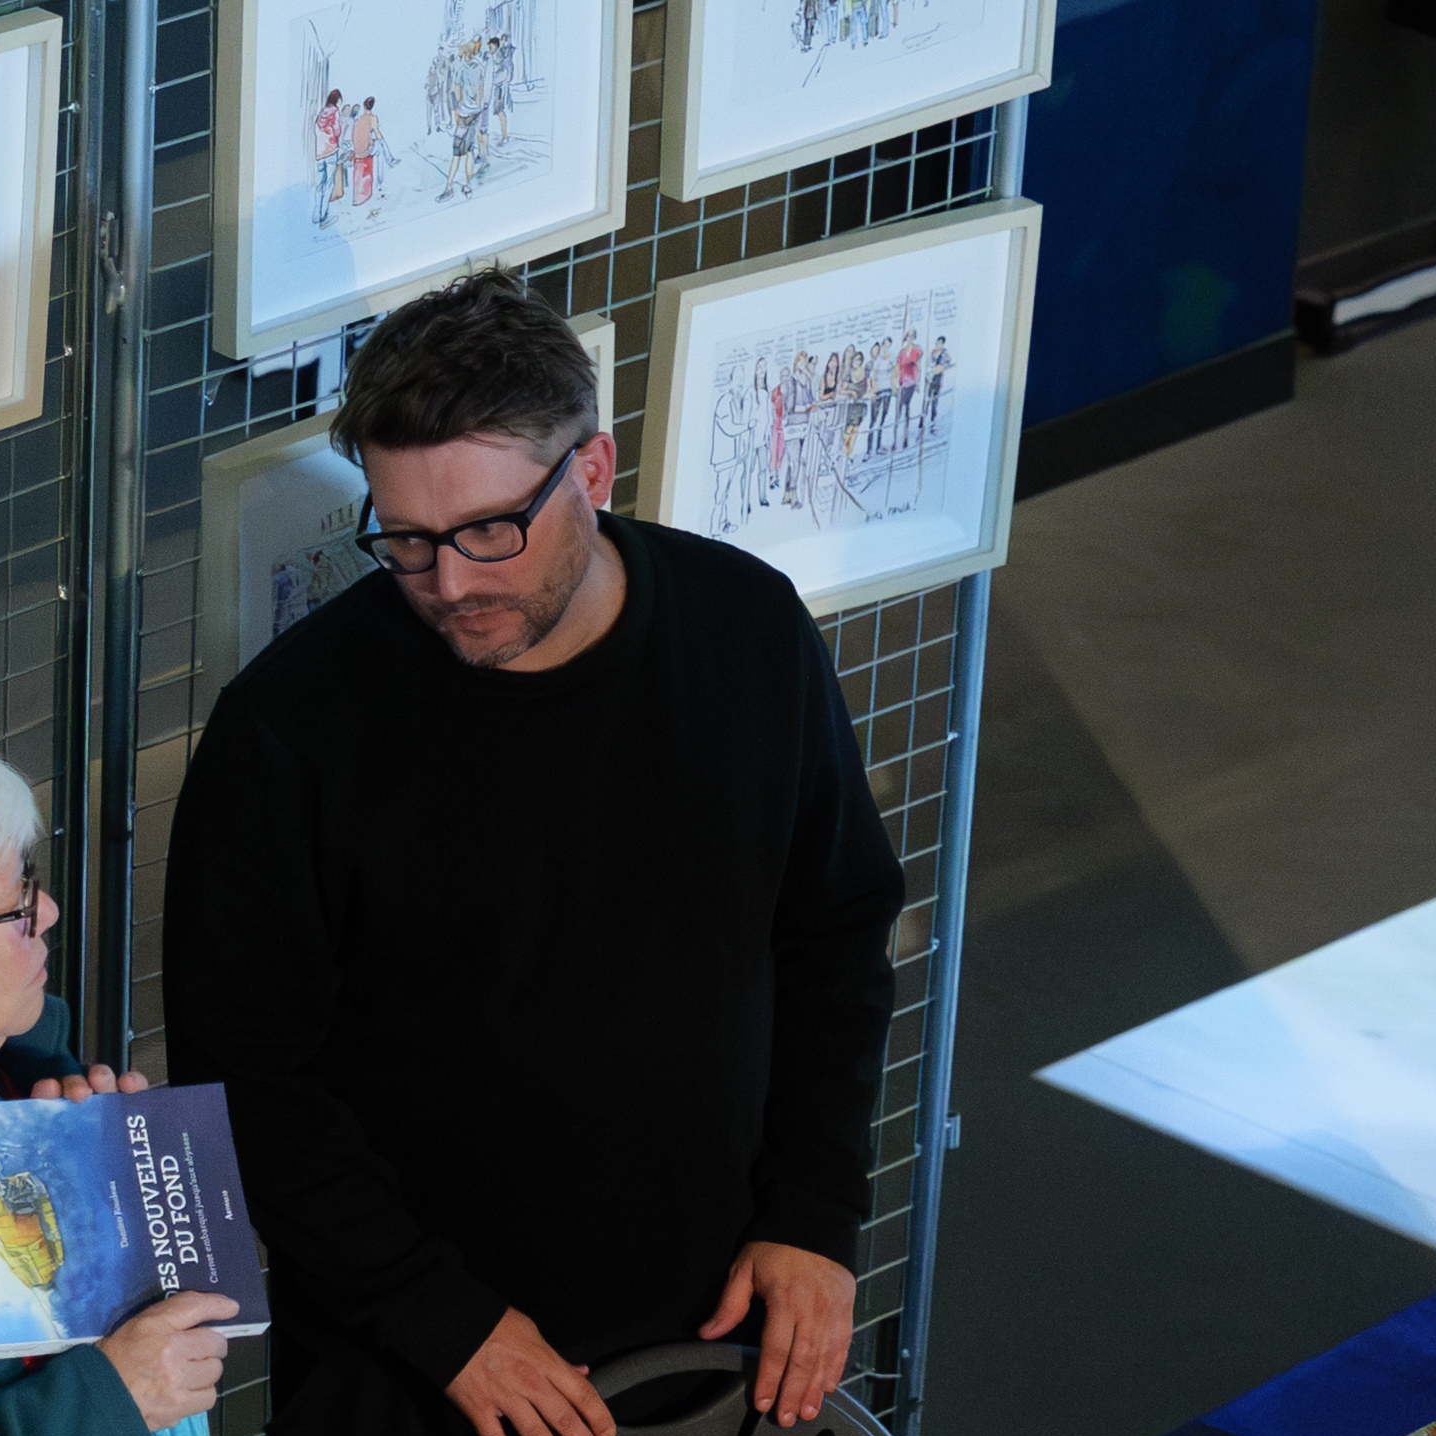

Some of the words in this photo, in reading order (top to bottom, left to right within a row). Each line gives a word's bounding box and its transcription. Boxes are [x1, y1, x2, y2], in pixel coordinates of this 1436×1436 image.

[127, 1115, 173, 1257] NOUVELLES
[160, 1155, 191, 1225] FOND
[174, 1229, 199, 1264] DU
